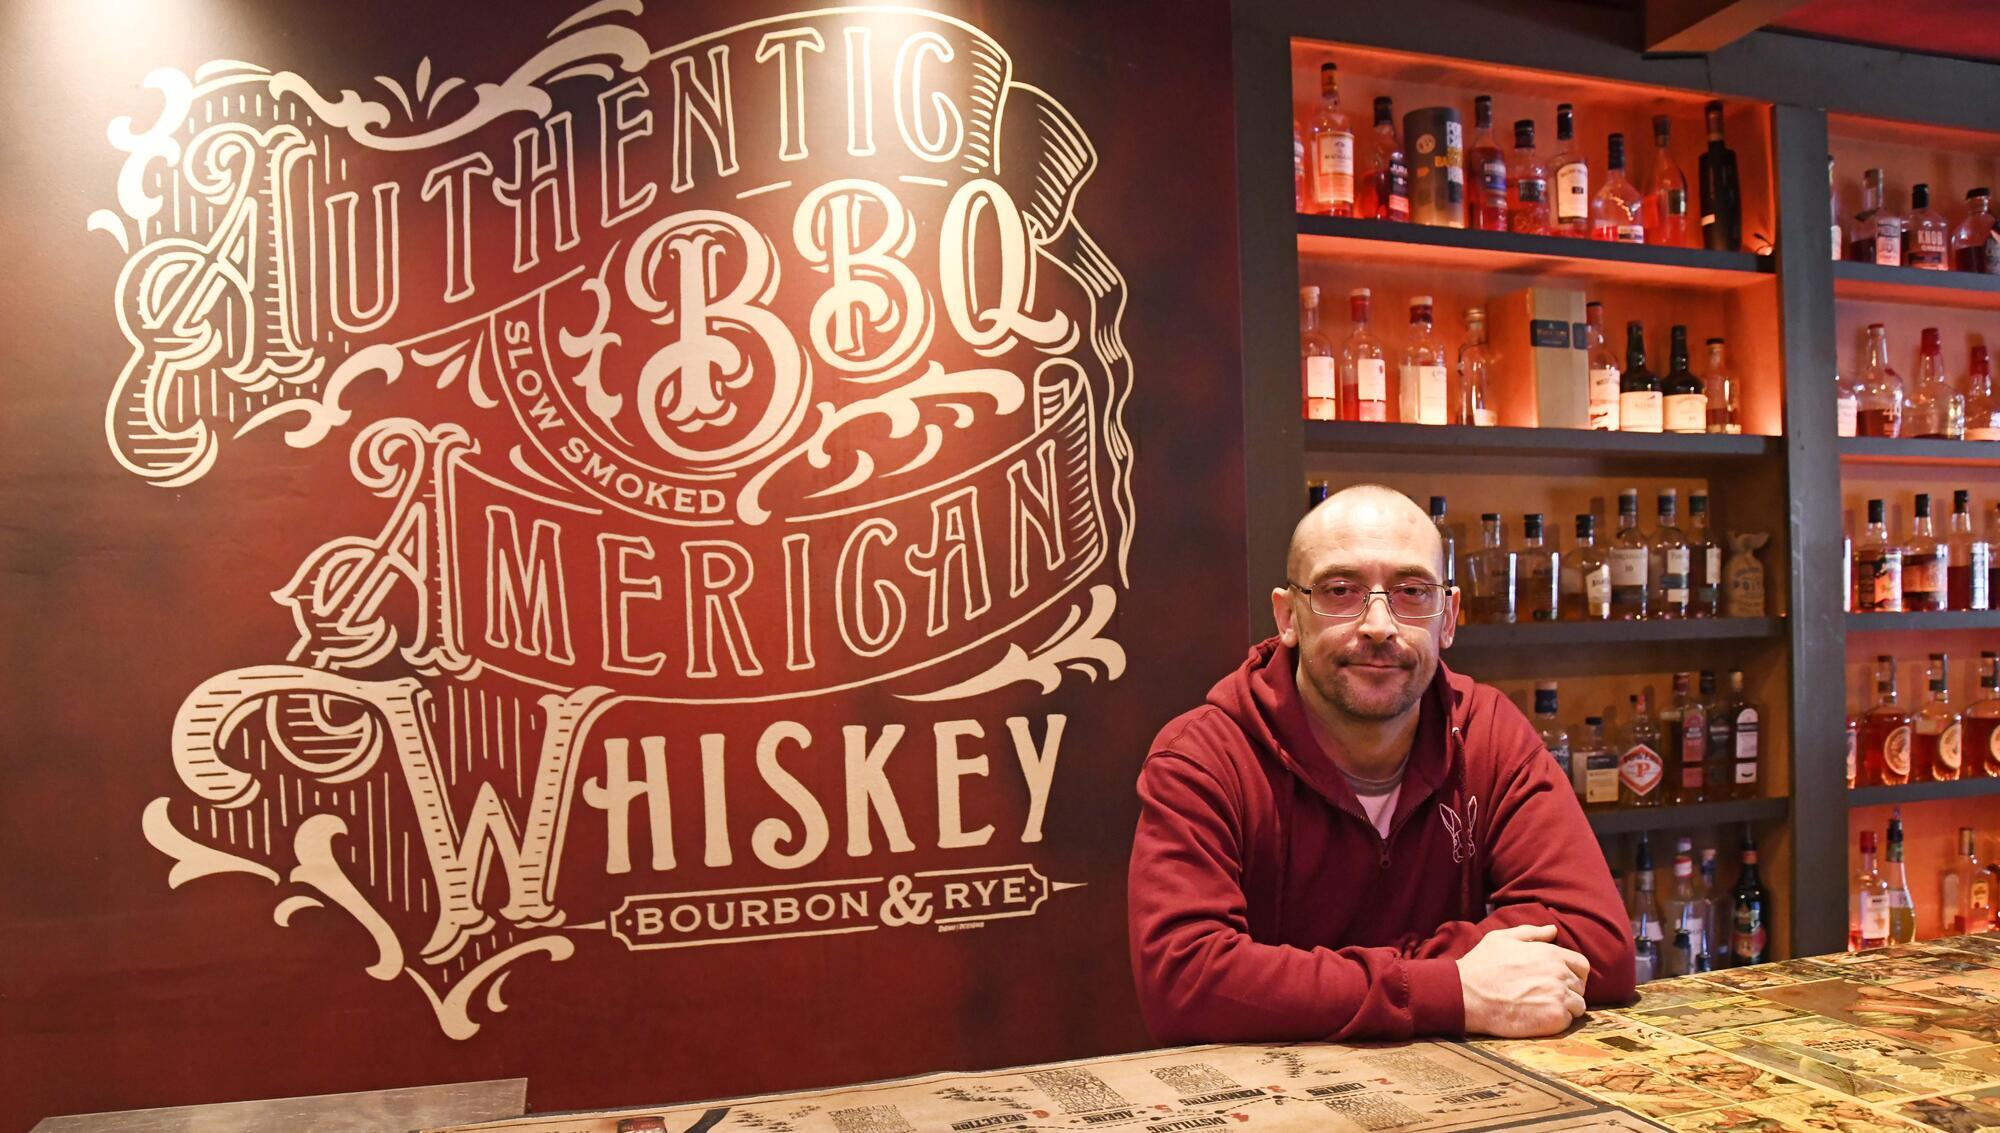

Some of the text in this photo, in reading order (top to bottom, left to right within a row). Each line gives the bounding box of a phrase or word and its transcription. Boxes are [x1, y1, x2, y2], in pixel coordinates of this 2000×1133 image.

[105, 25, 963, 488] AUTHENTIC
[624, 178, 1074, 466] BBQ
[504, 320, 726, 514] SLOW SMOKED
[270, 417, 1066, 682] AMERICAN
[171, 665, 1067, 963] WHISKEY
[637, 874, 1027, 936] BOURBON & RYE
[951, 1113, 1028, 1131] SELECTION
[1082, 1110, 1134, 1124] AGEING
[1146, 1117, 1227, 1133] DISTILLING
[1178, 1089, 1267, 1106] FERMENTING
